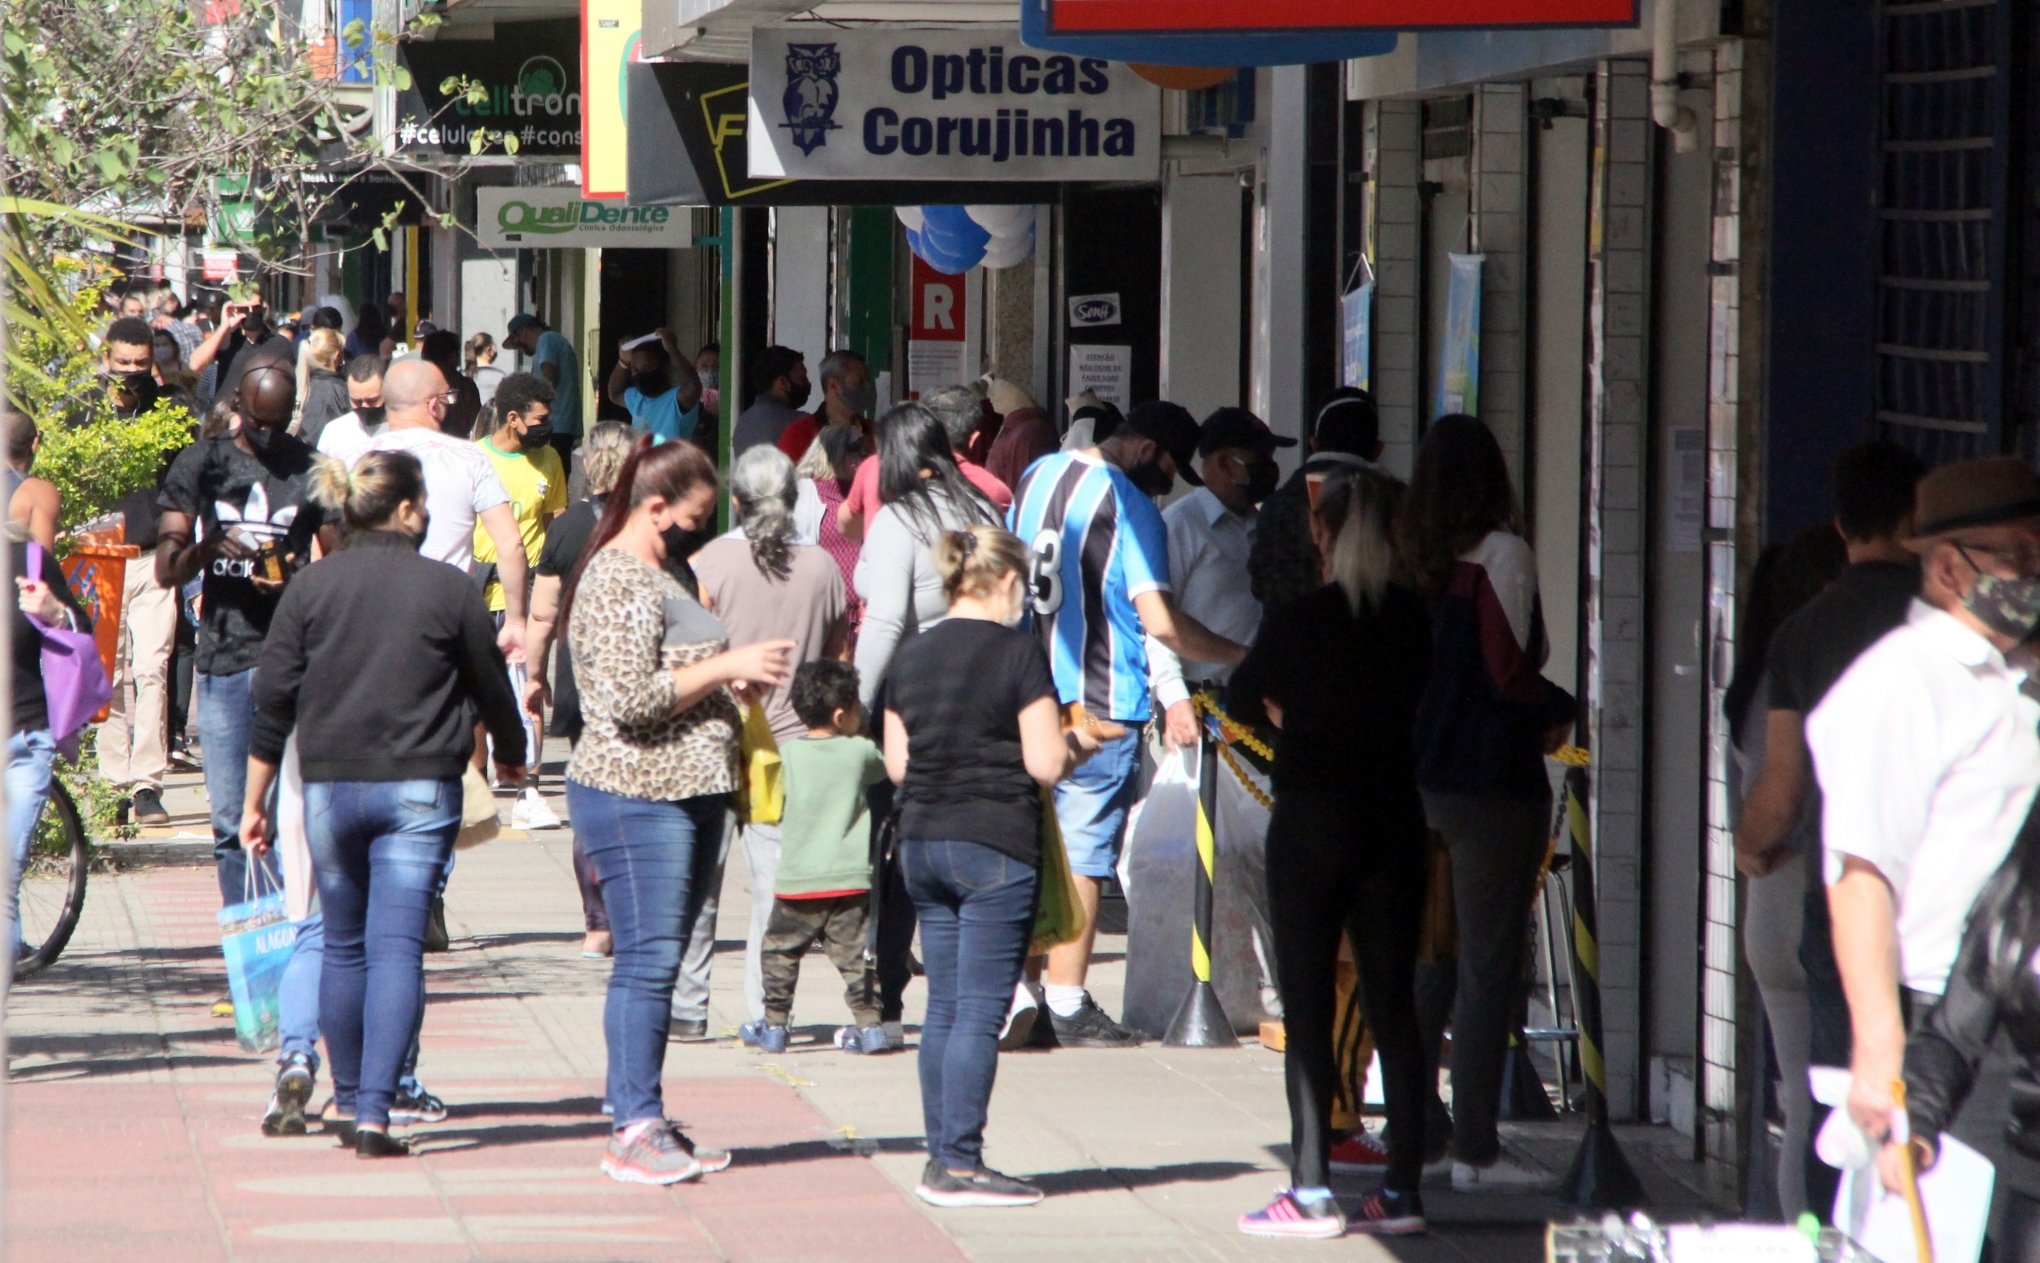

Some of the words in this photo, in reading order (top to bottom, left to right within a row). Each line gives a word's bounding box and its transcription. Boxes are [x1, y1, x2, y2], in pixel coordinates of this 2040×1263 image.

[891, 45, 1110, 99] Opticas
[862, 106, 1136, 162] Corujinha
[497, 201, 669, 231] QualiDente
[923, 283, 955, 330] R
